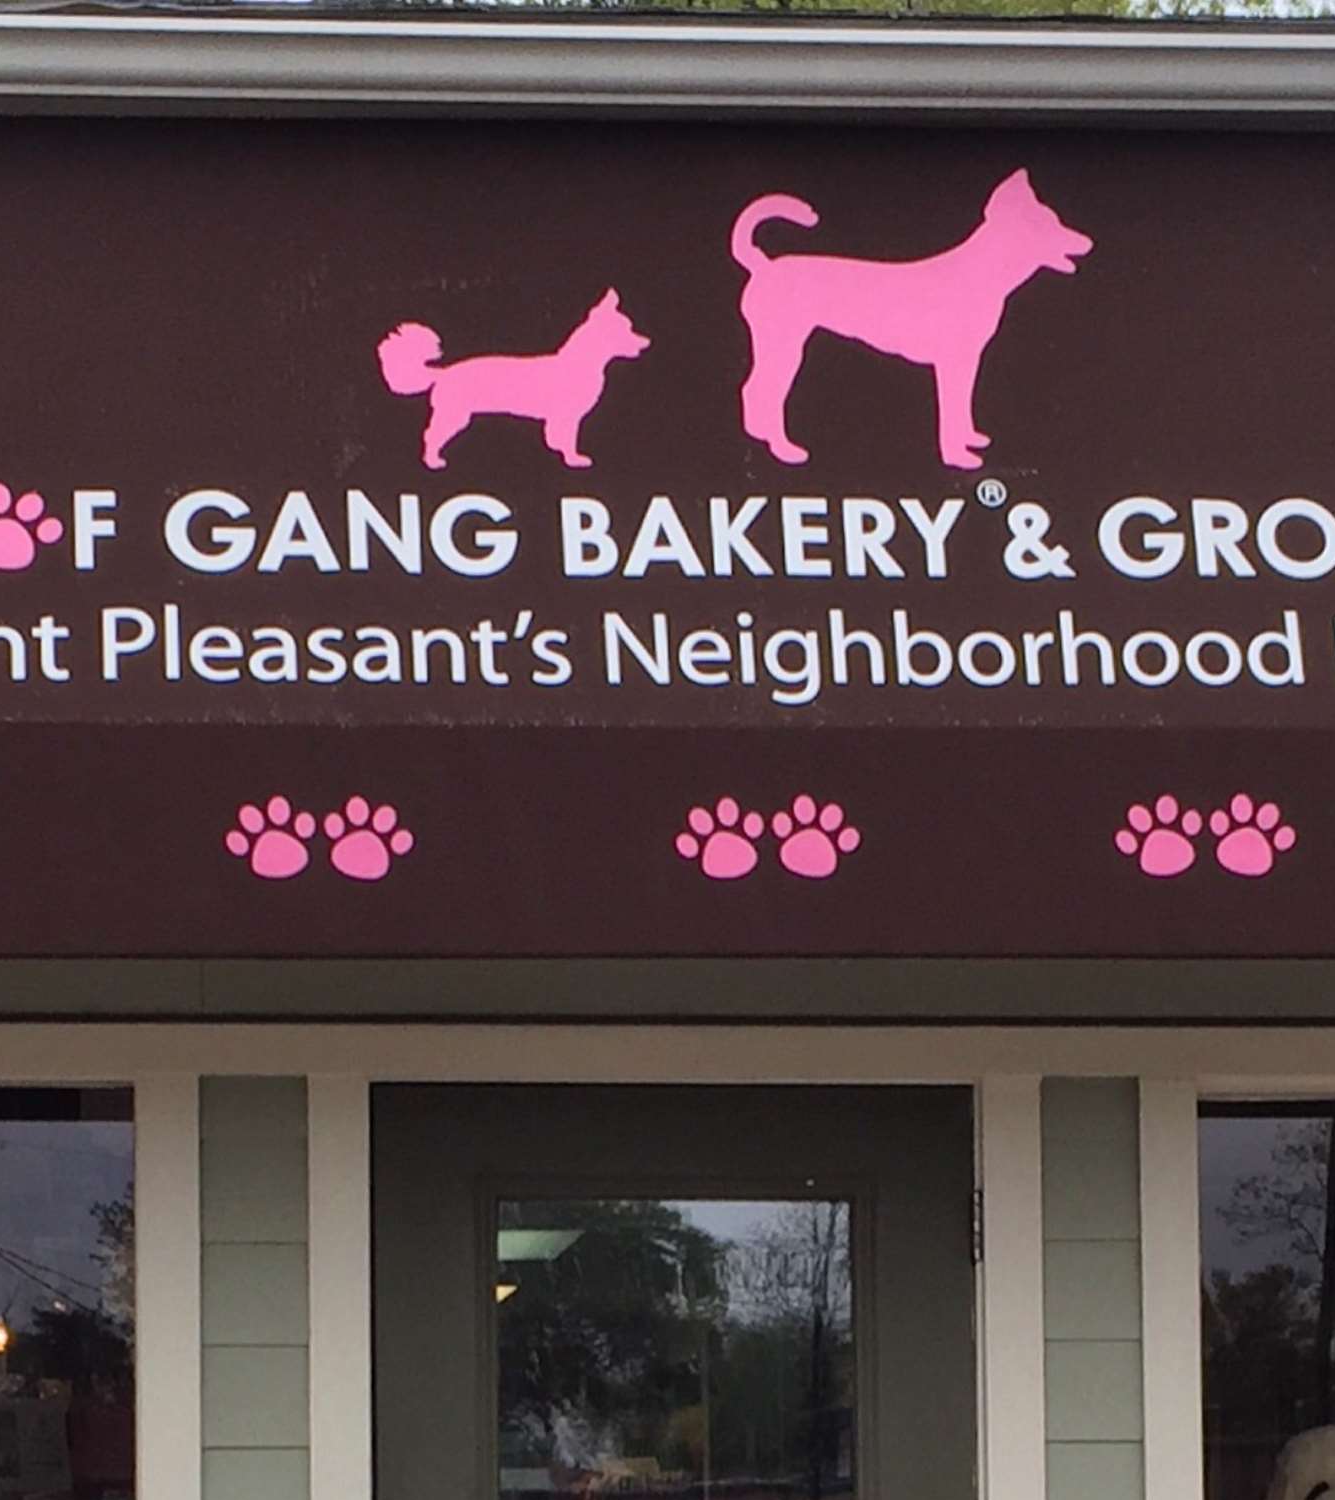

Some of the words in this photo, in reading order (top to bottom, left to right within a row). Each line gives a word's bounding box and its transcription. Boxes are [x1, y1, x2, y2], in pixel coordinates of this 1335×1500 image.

[163, 488, 519, 577] GANG
[1002, 501, 1077, 580] &
[101, 603, 573, 685] Pleasant’s
[603, 608, 1306, 702] Neighborhood
